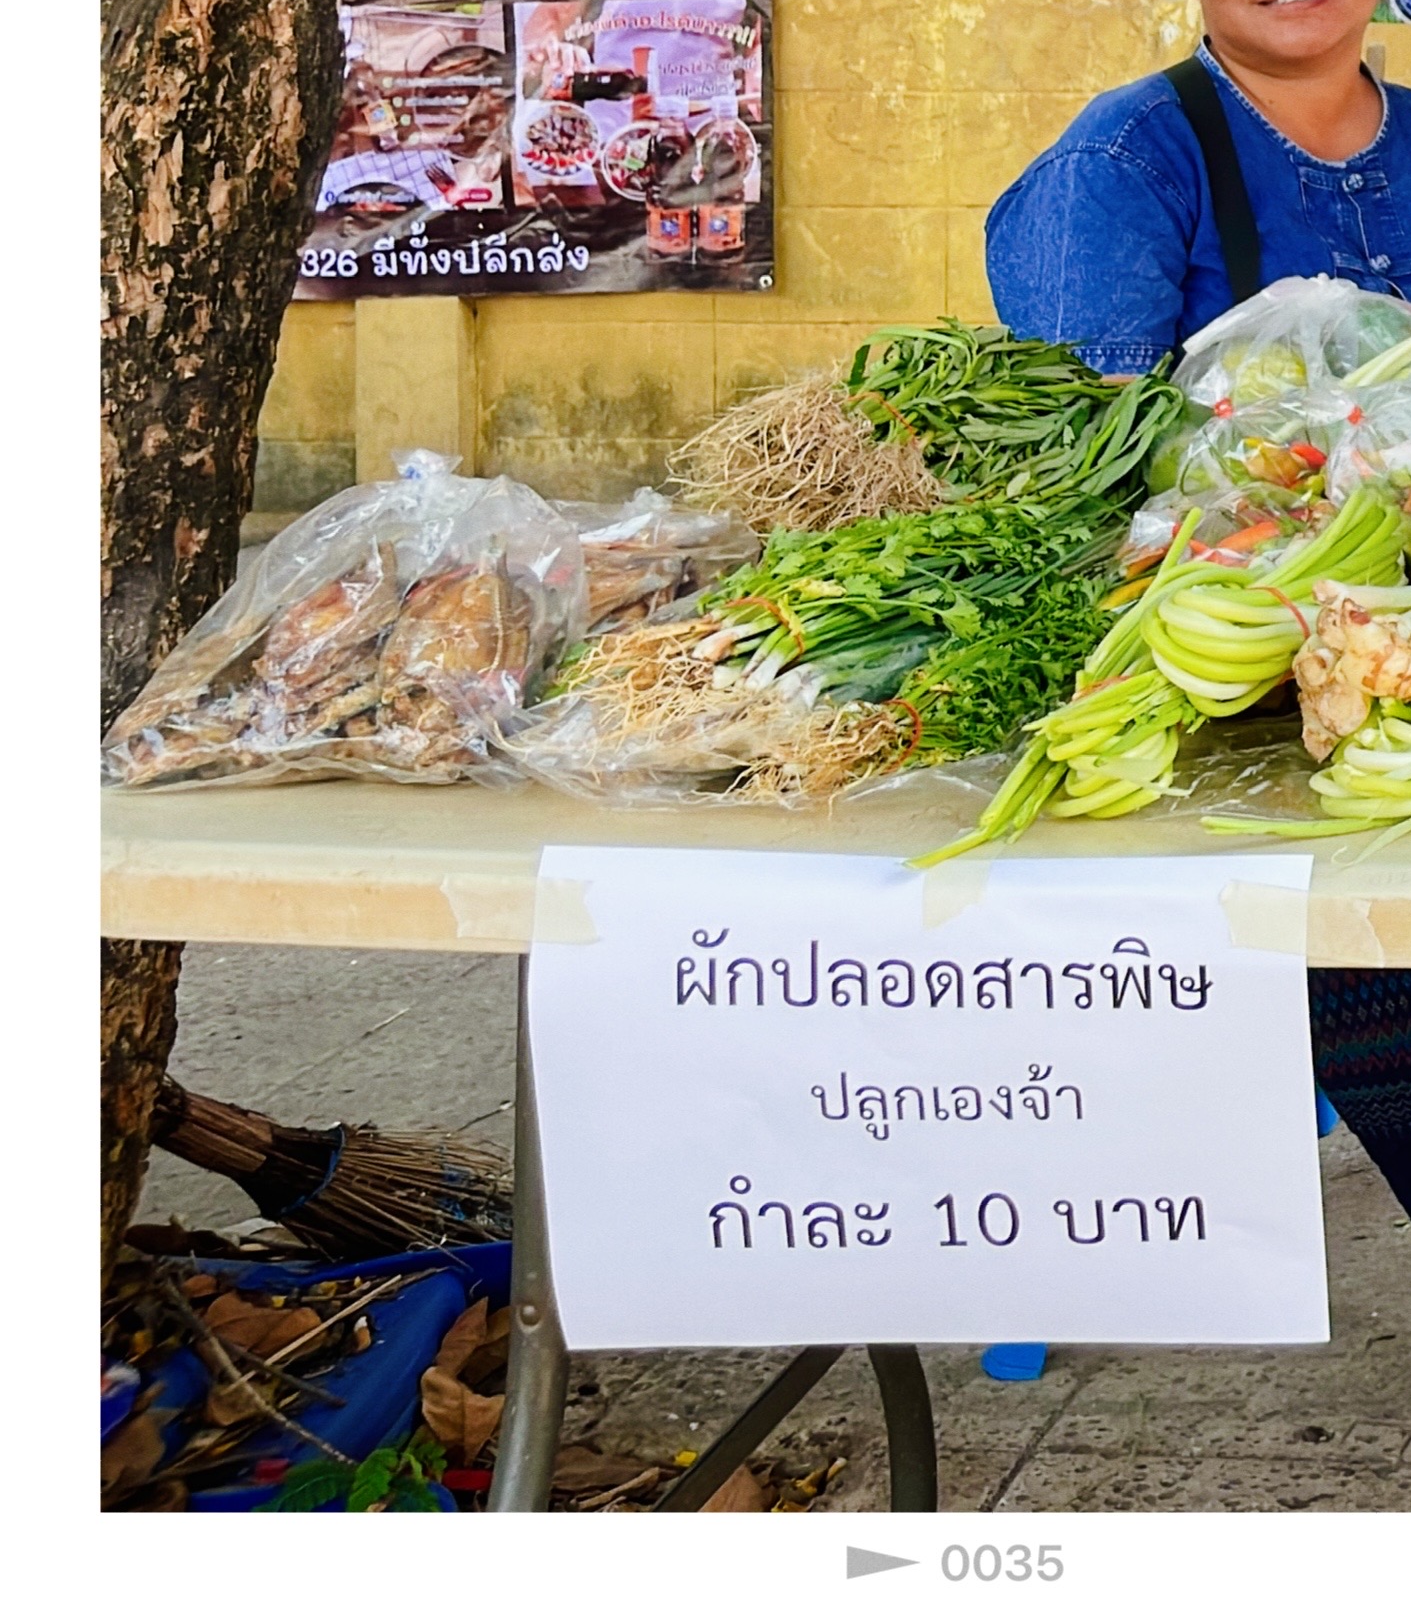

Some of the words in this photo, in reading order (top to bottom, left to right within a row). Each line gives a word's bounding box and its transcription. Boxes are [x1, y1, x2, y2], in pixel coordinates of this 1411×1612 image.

[300, 248, 358, 277] 326
[372, 221, 590, 277] มีทั้งปลีกส่ง
[675, 928, 1213, 1011] ผักปลอดสารพิษ
[810, 1063, 1085, 1141] ปลูกเองจ้า
[709, 1175, 892, 1250] กำละ
[934, 1192, 1021, 1248] 10
[1053, 1192, 1208, 1245] บาท
